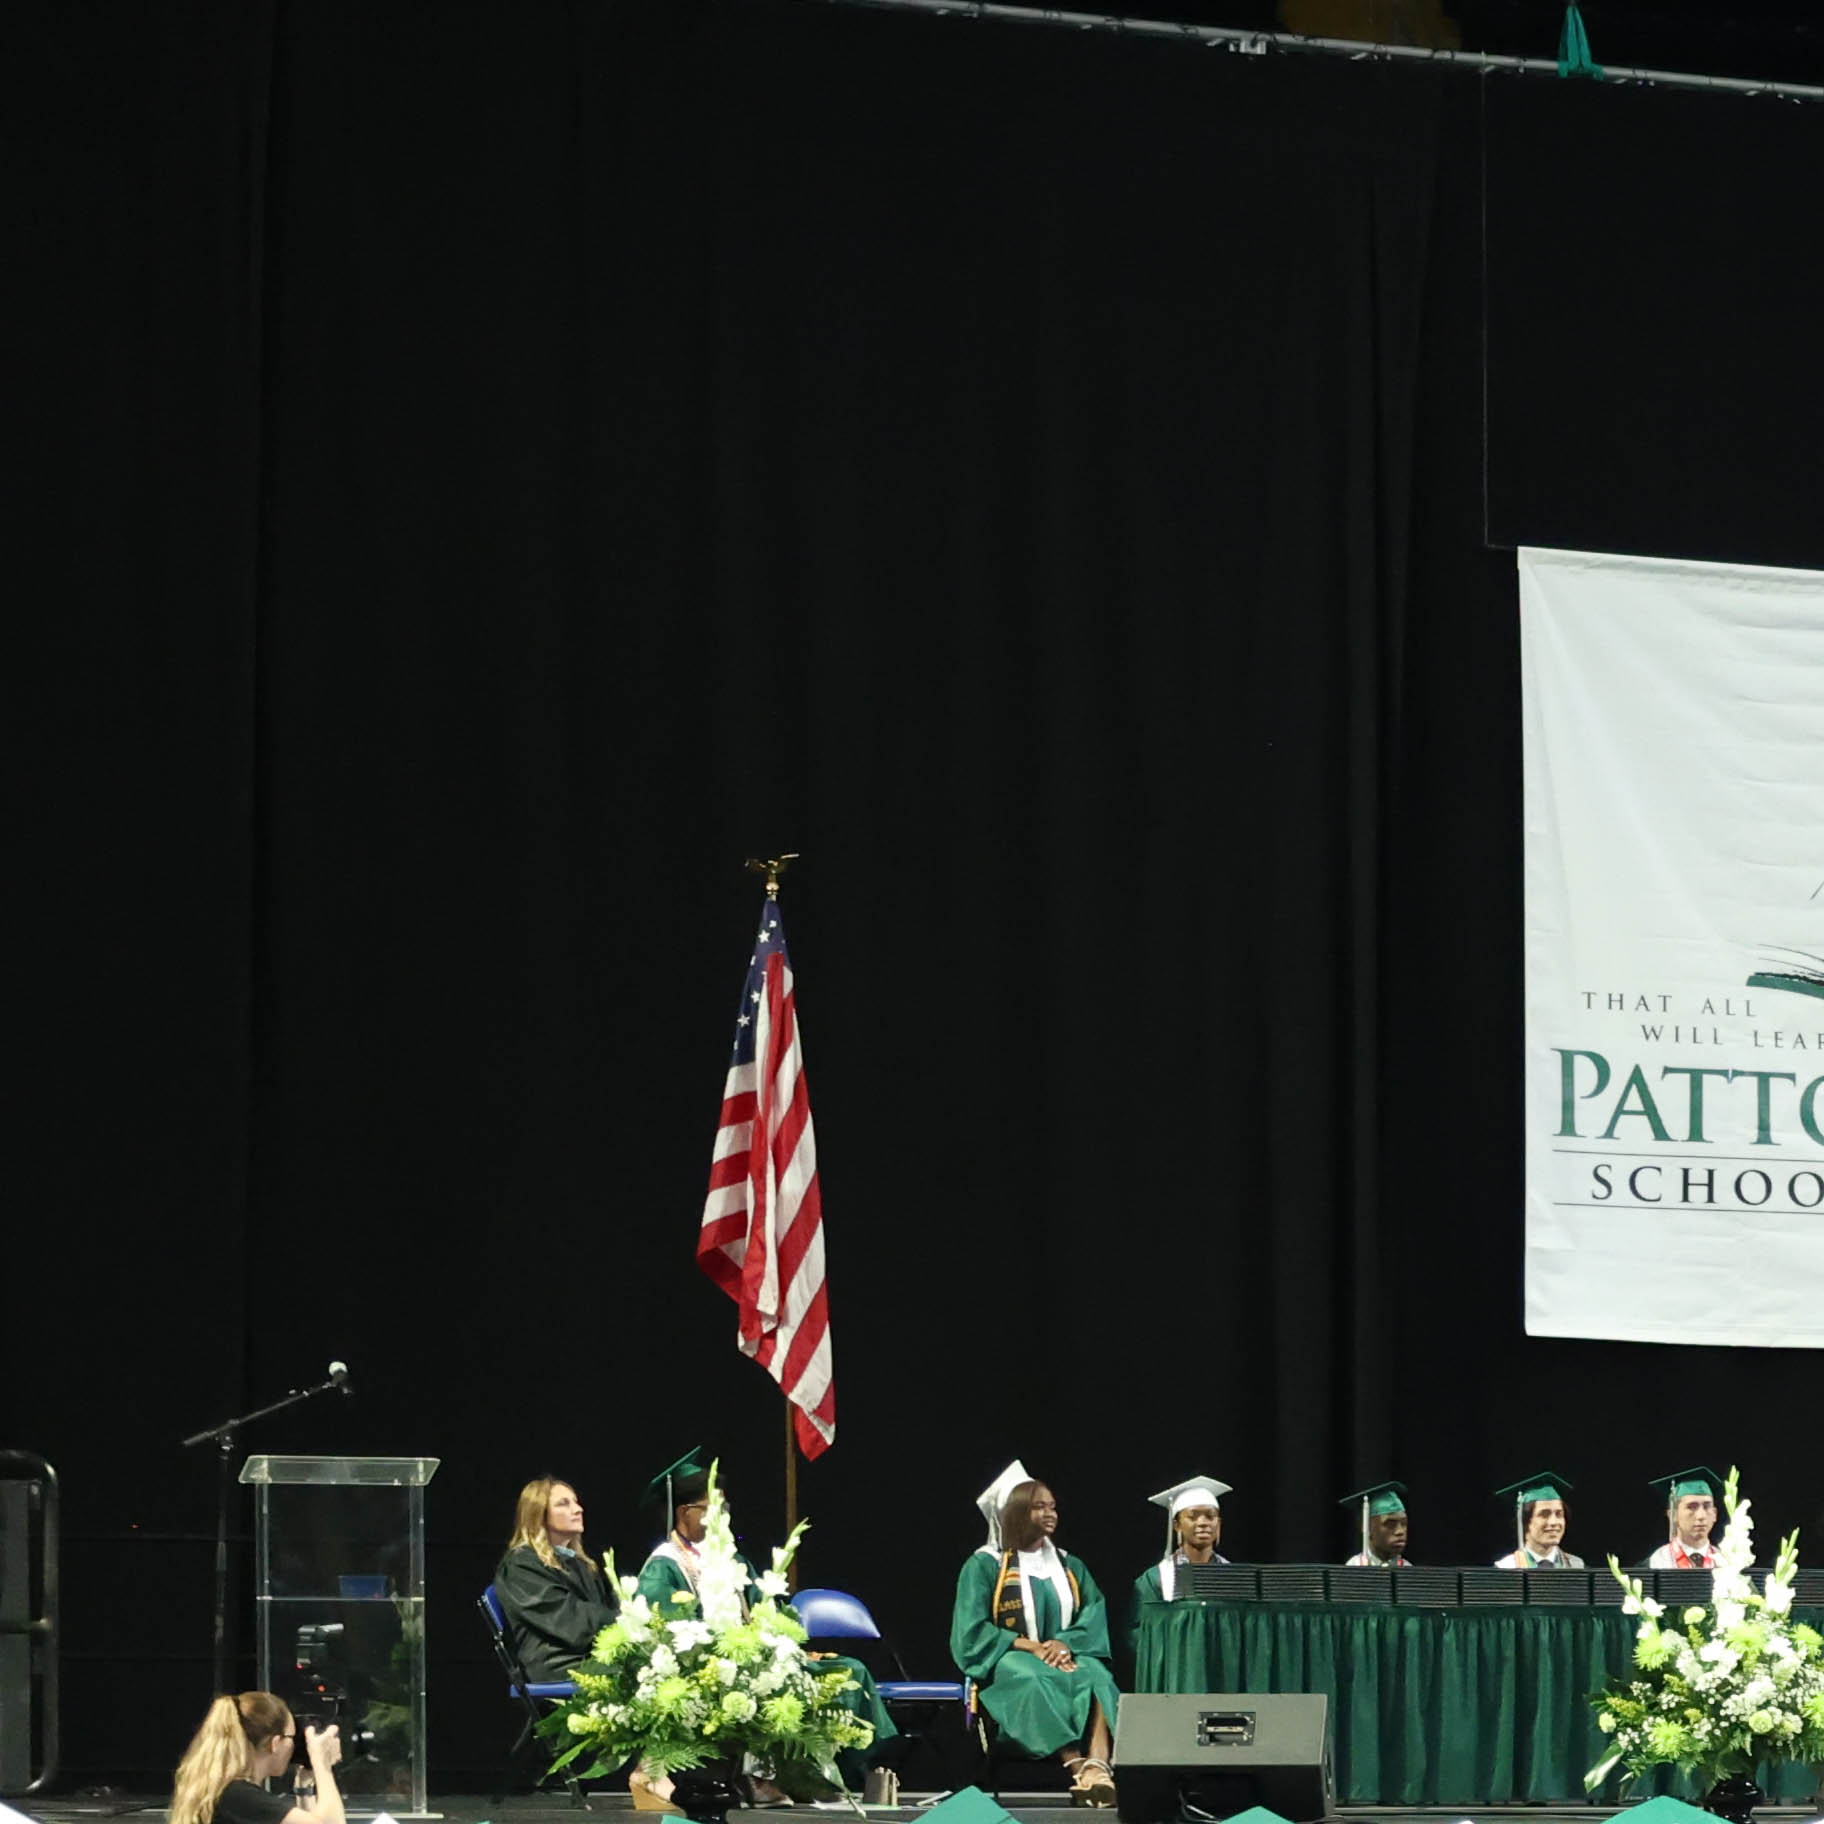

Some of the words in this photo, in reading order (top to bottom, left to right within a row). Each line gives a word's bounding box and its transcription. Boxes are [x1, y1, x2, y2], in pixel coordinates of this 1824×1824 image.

[1581, 990, 1674, 1014] THAT
[1701, 997, 1757, 1018] ALL
[1640, 1023, 1726, 1046] WILL
